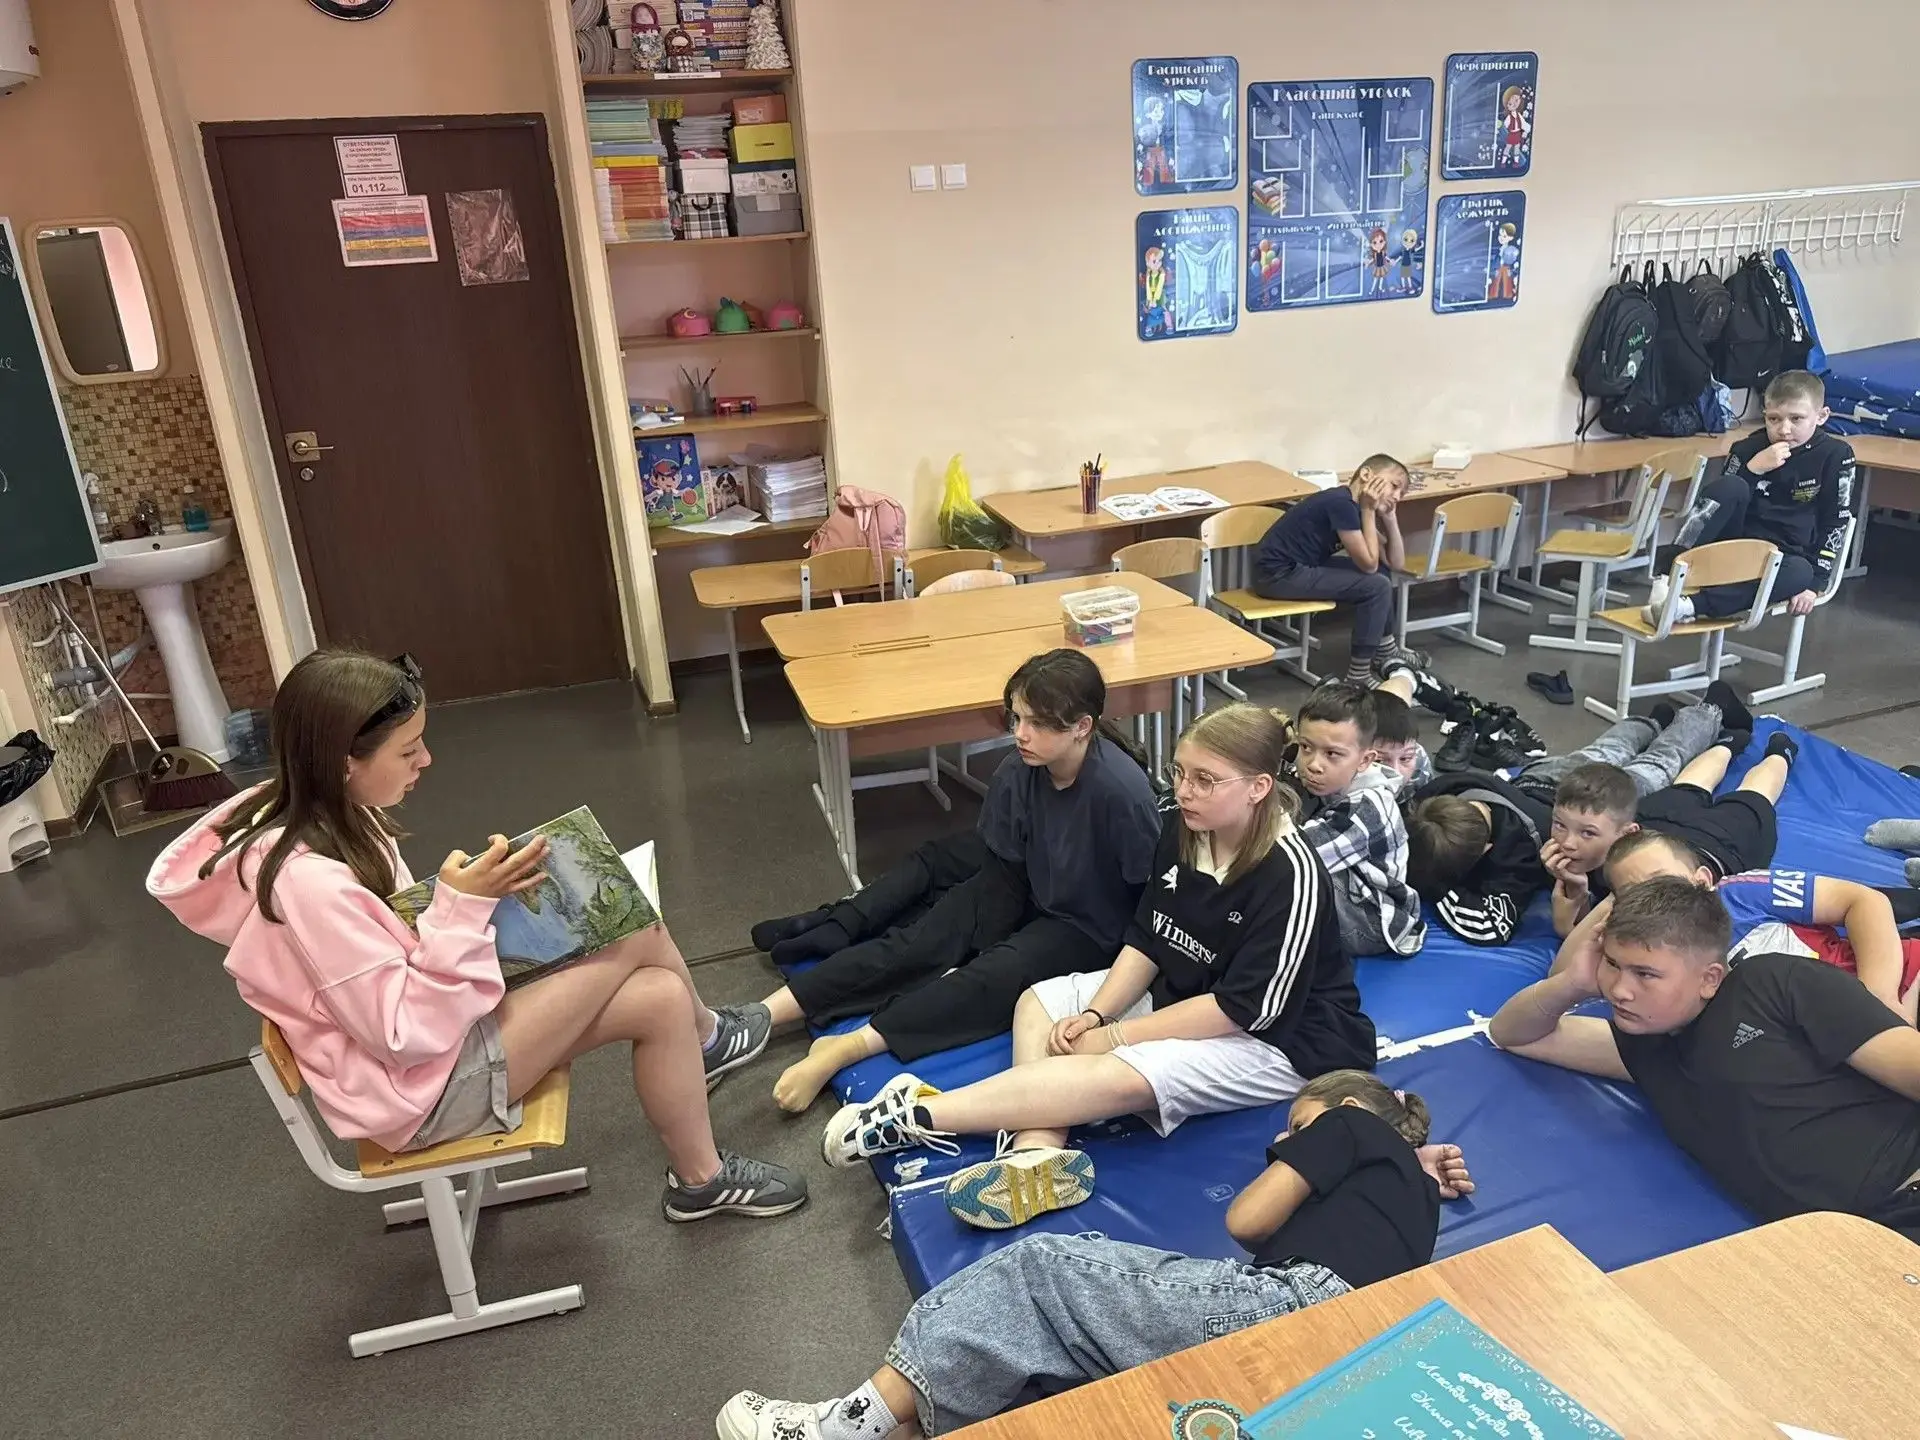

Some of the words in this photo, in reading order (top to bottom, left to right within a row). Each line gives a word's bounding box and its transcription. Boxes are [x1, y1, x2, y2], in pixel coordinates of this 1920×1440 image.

[1147, 65, 1225, 76] Расписание
[1455, 61, 1530, 72] Мероприятия
[1273, 85, 1356, 102] Классный
[1359, 86, 1412, 100] уголок
[1732, 1029, 1765, 1049] adidas
[1467, 1403, 1511, 1438] народа
